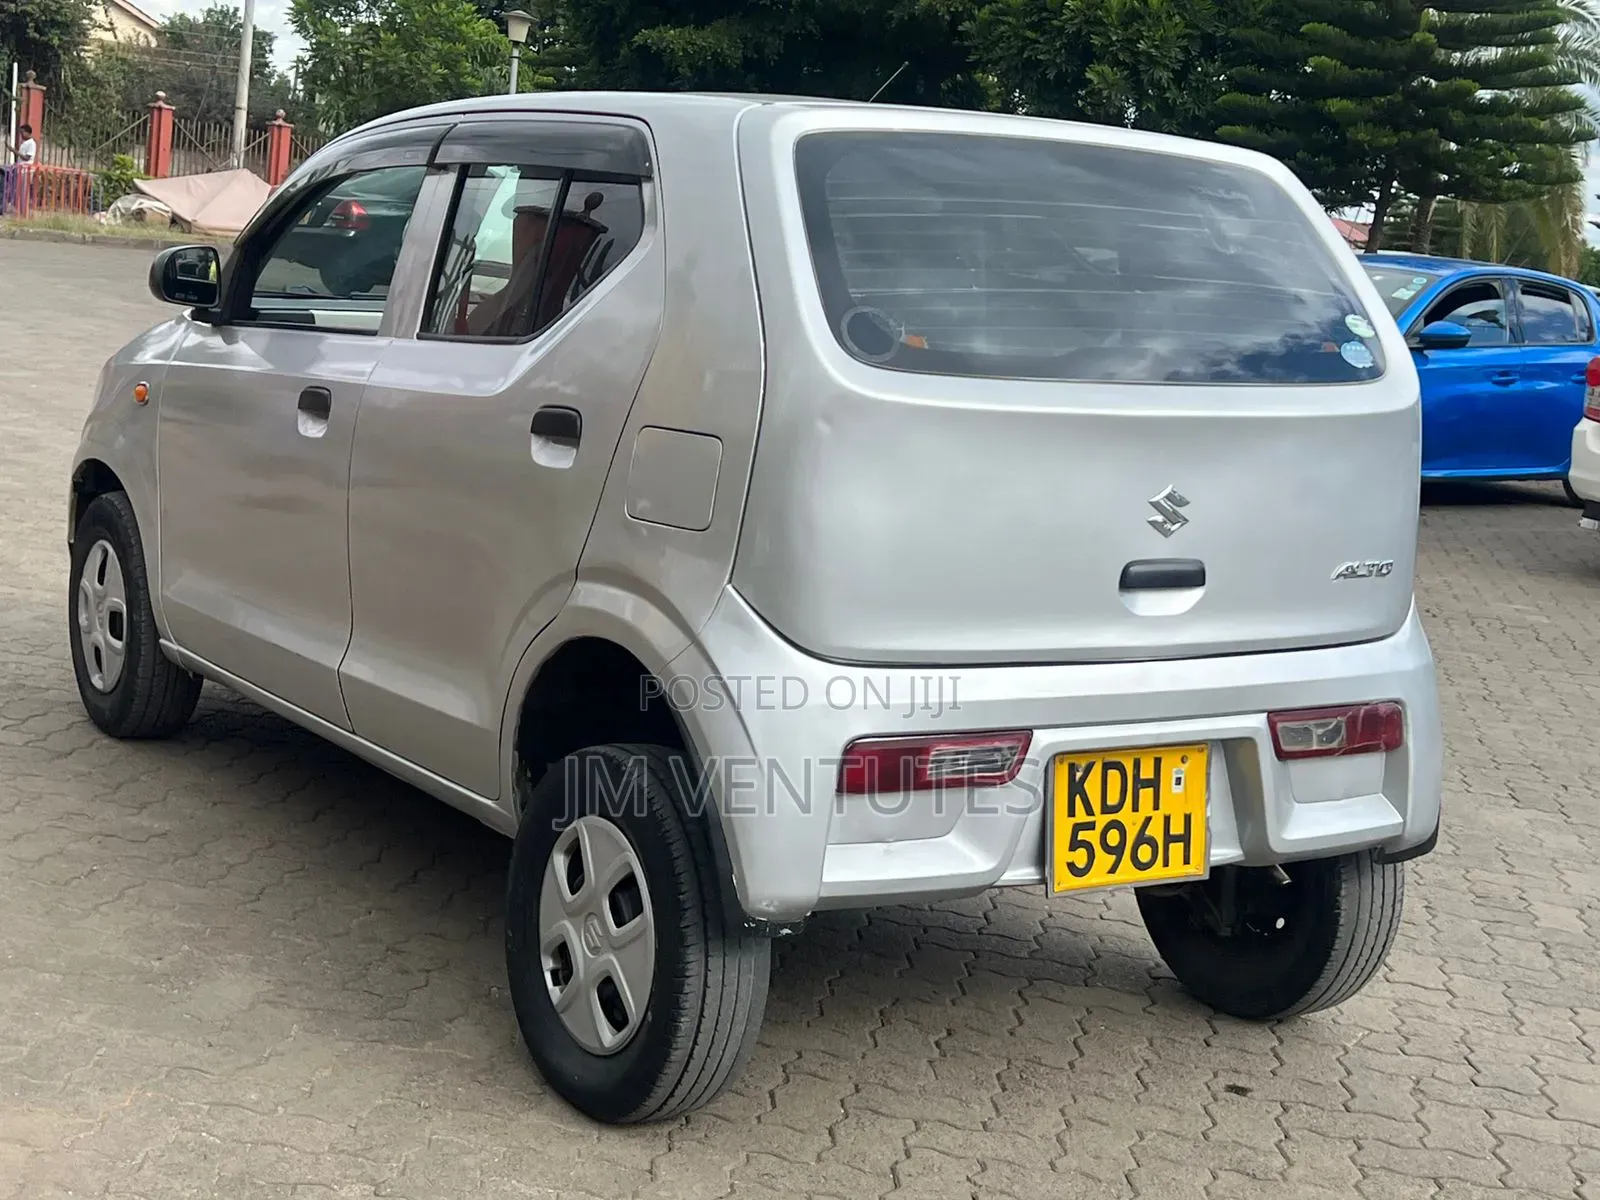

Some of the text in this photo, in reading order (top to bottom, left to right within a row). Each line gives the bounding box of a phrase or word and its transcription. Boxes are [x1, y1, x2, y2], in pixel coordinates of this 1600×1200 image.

[1330, 560, 1394, 580] ALTO
[1067, 757, 1163, 818] KDH
[1066, 812, 1192, 878] 596H
